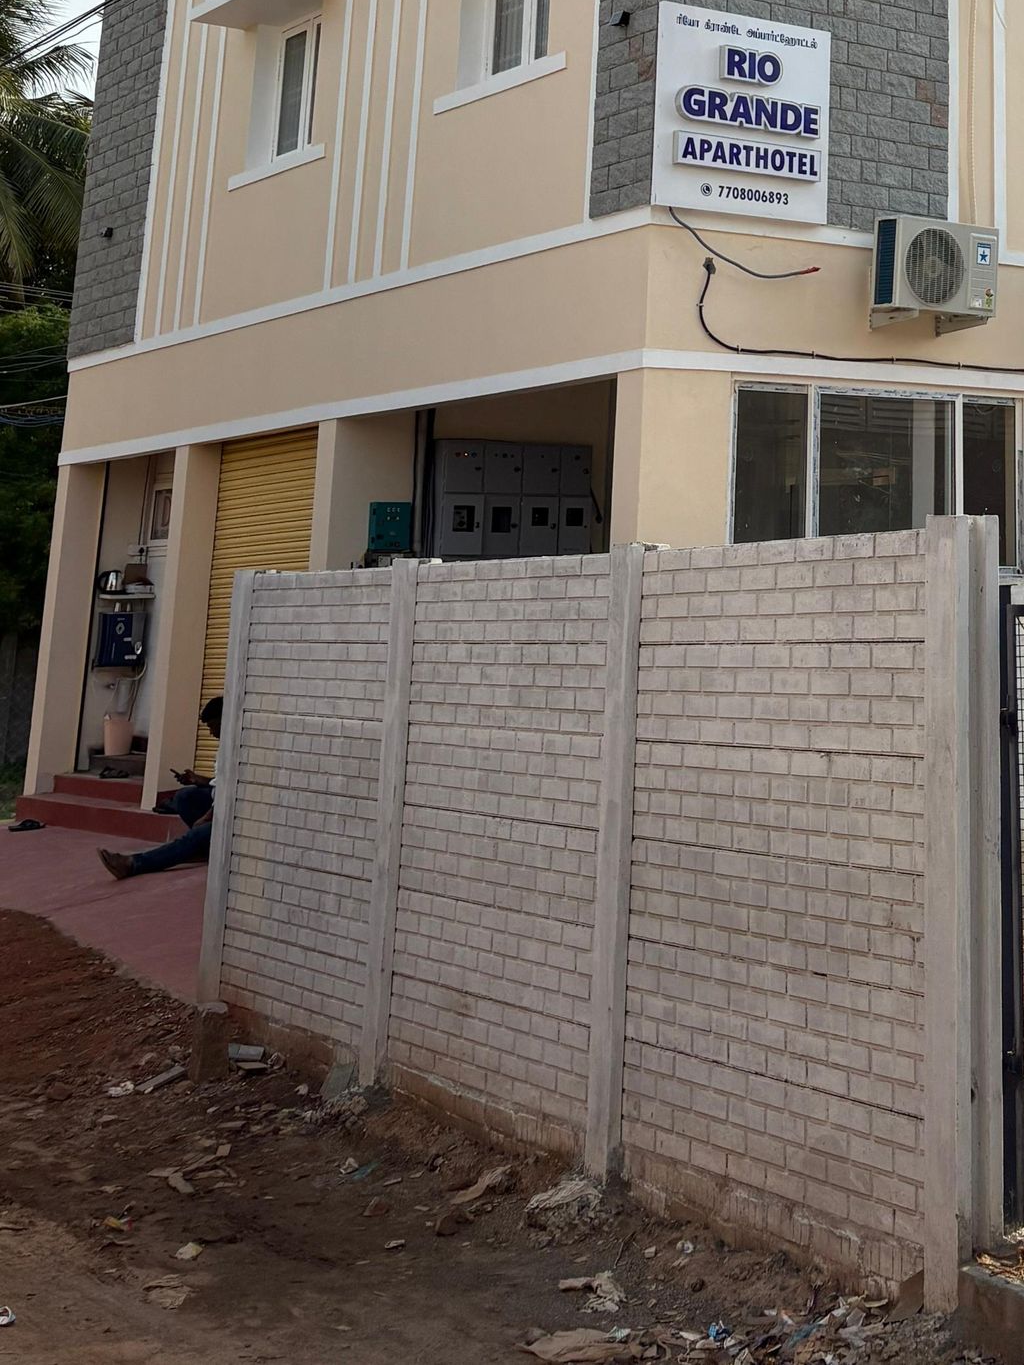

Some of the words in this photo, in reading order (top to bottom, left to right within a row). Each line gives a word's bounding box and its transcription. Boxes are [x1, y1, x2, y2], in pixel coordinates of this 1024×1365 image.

[726, 48, 781, 83] RIO
[682, 87, 819, 136] GRANDE
[682, 136, 818, 176] APARTHOTEL
[718, 185, 789, 205] 7708006893
